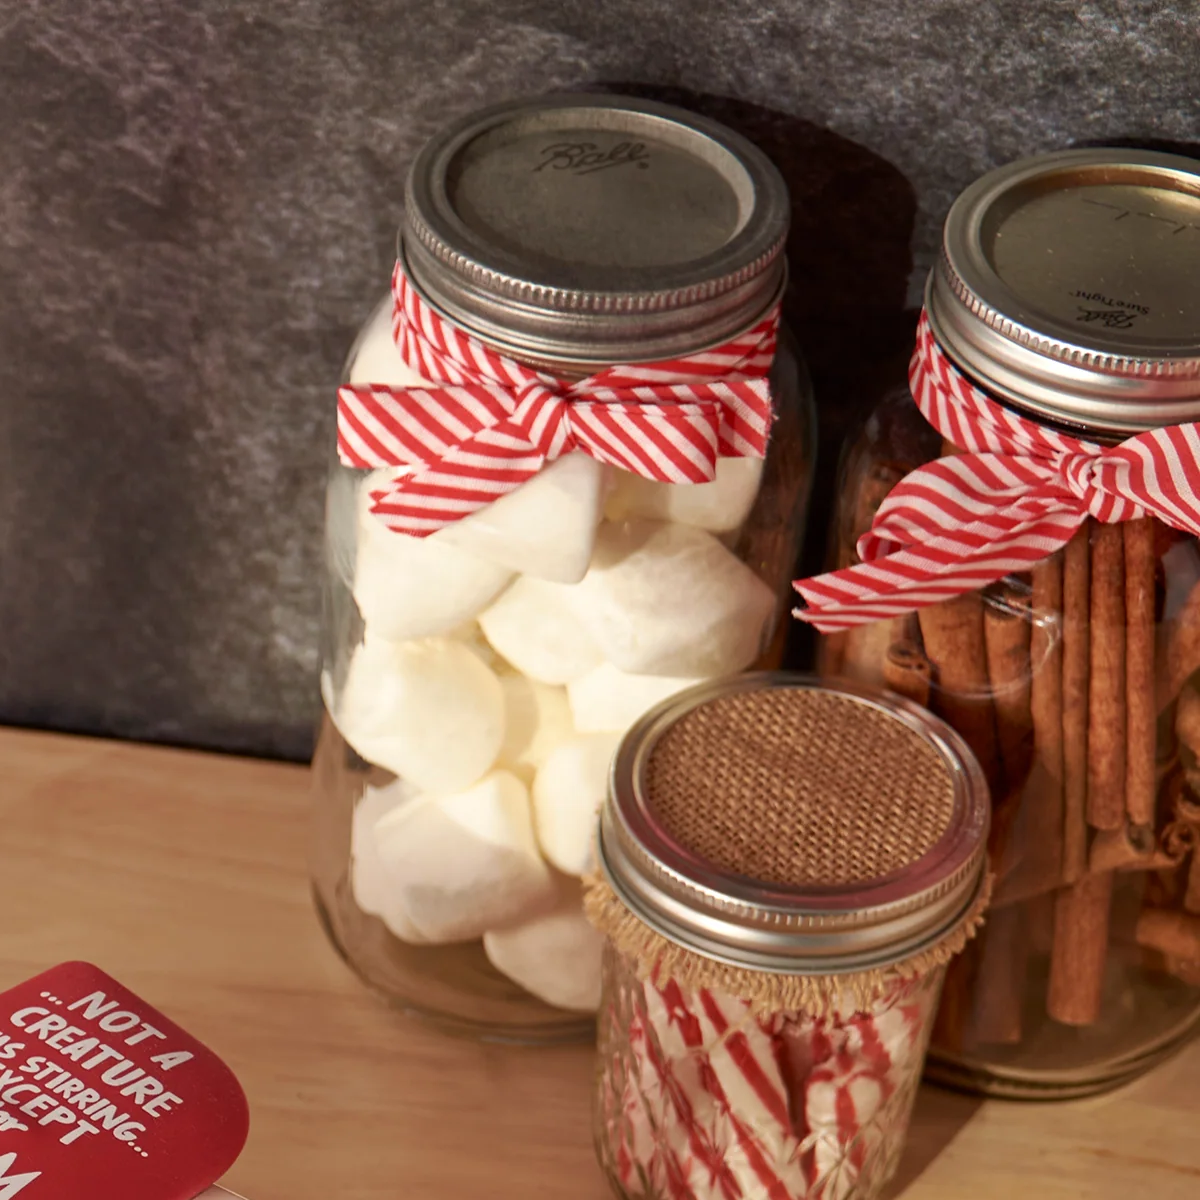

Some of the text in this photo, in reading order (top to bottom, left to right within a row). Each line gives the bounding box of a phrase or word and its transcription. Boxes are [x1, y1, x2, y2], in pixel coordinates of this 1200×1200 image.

[533, 142, 648, 175] Ball
[9, 1006, 184, 1118] CREATURE
[150, 1050, 194, 1071] A
